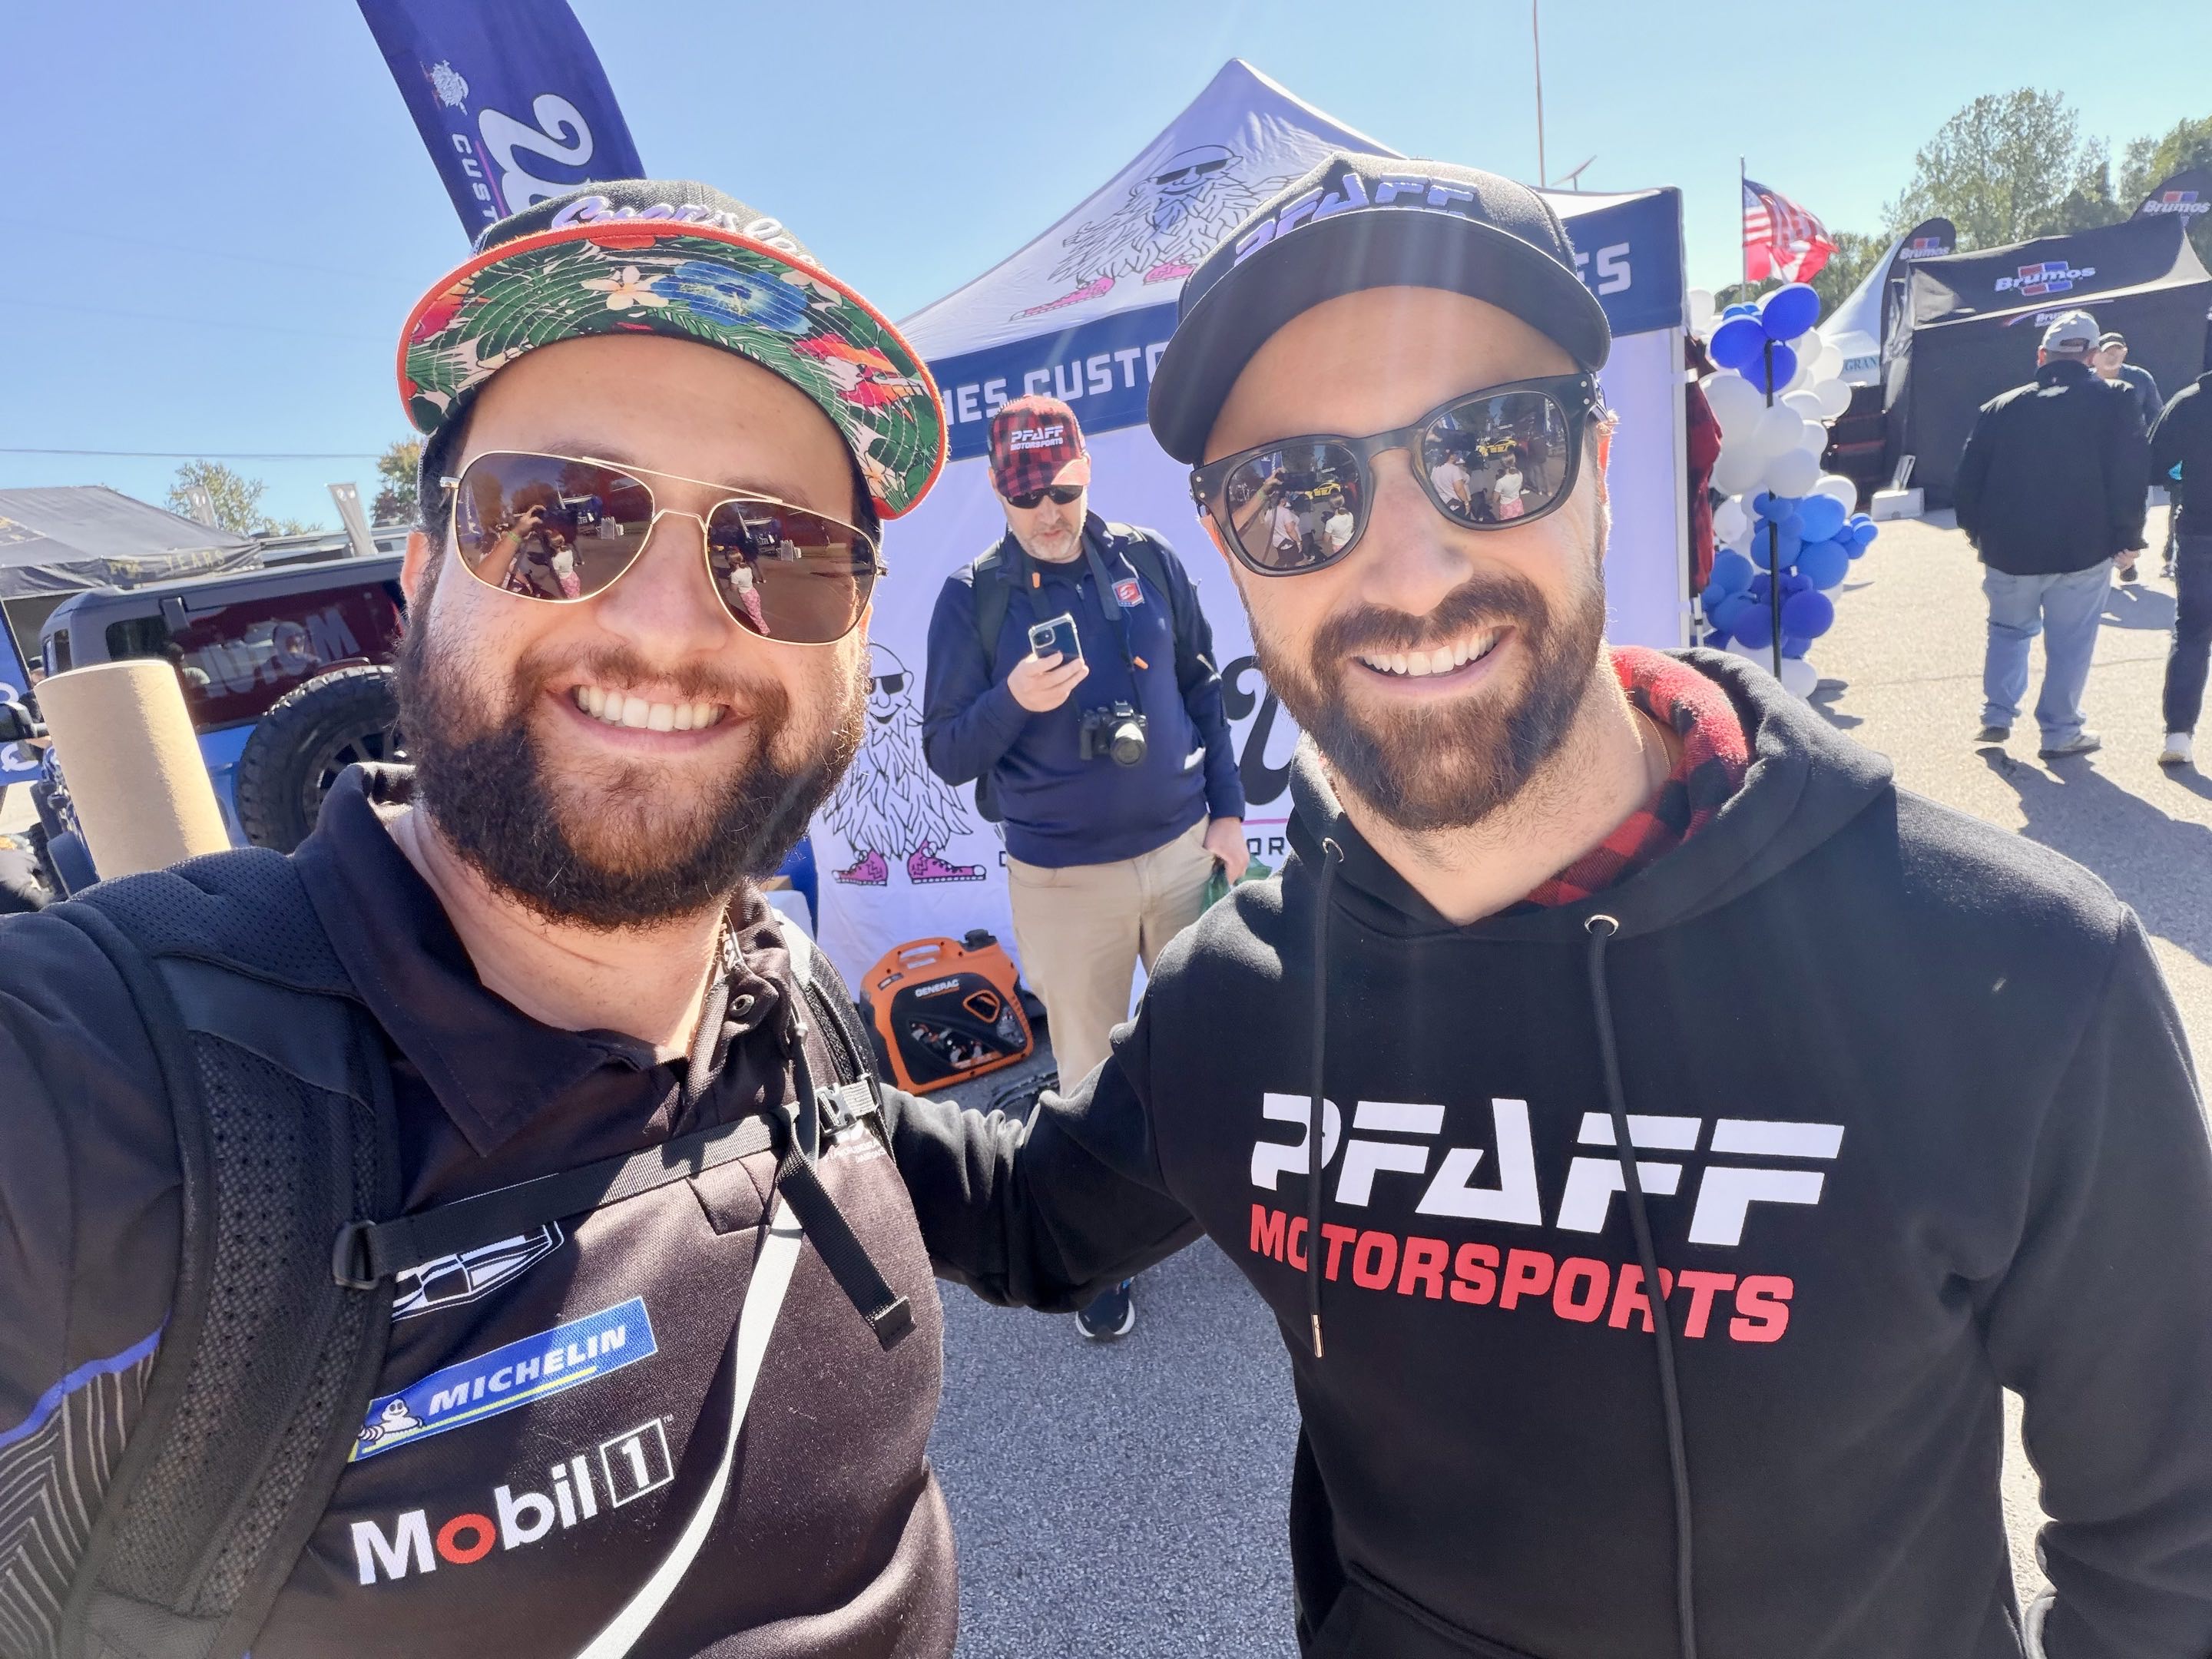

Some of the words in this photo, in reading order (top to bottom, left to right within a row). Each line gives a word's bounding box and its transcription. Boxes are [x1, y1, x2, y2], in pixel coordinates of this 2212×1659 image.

[2142, 200, 2211, 214] Brumos
[1899, 247, 1950, 260] Brumos
[1995, 267, 2096, 292] Brumos
[1010, 425, 1064, 443] PFAFF
[1010, 437, 1064, 451] MOTORSPORTS
[915, 979, 959, 998] GENERAC
[1250, 1091, 1845, 1246] PFAFF
[1250, 1204, 1794, 1343] MOTORSPORTS
[429, 1324, 626, 1416] MICHELIN
[351, 1454, 598, 1584] Mobil
